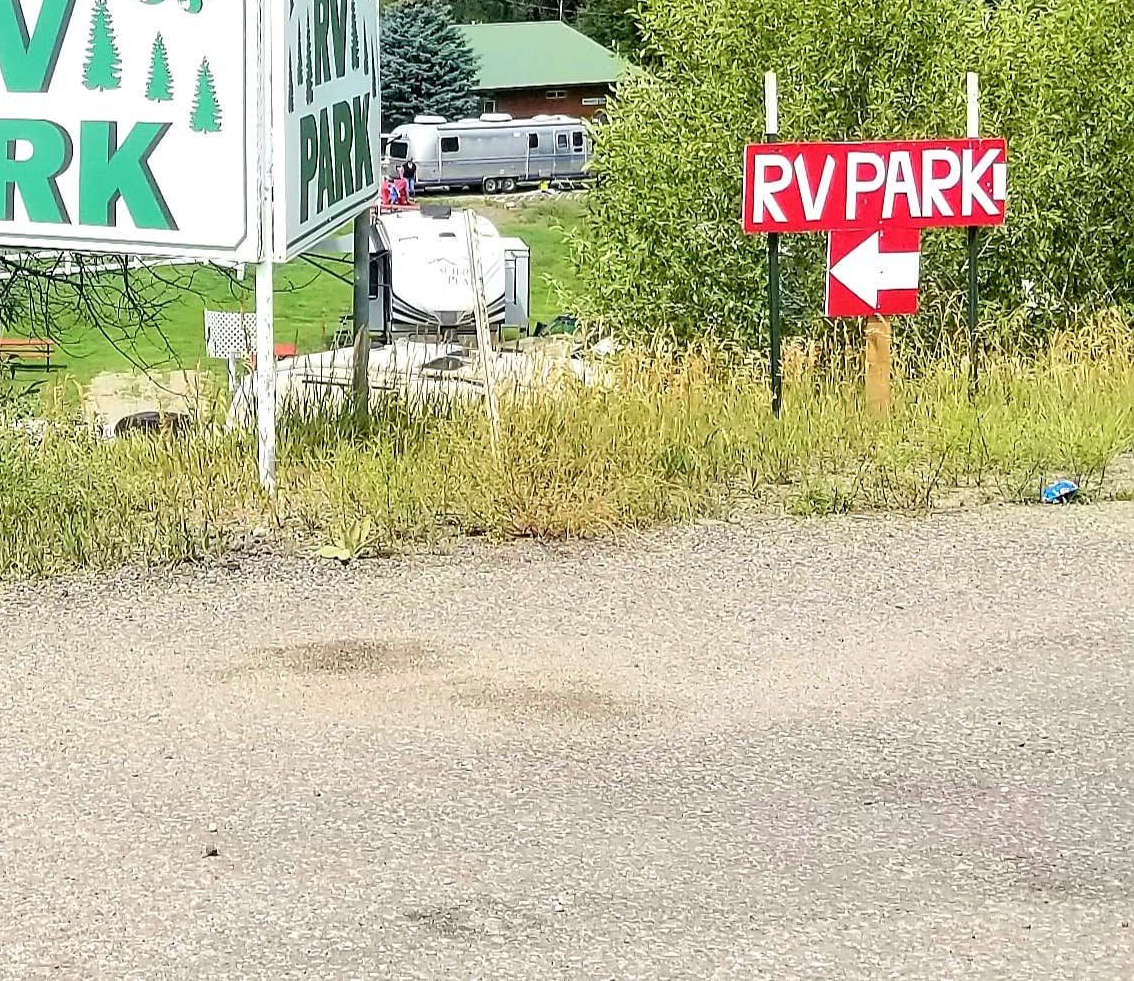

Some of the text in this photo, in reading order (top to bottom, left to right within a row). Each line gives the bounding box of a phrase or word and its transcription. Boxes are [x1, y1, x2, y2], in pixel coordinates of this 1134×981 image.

[299, 92, 374, 224] PARK
[753, 148, 1002, 224] RV PARK
